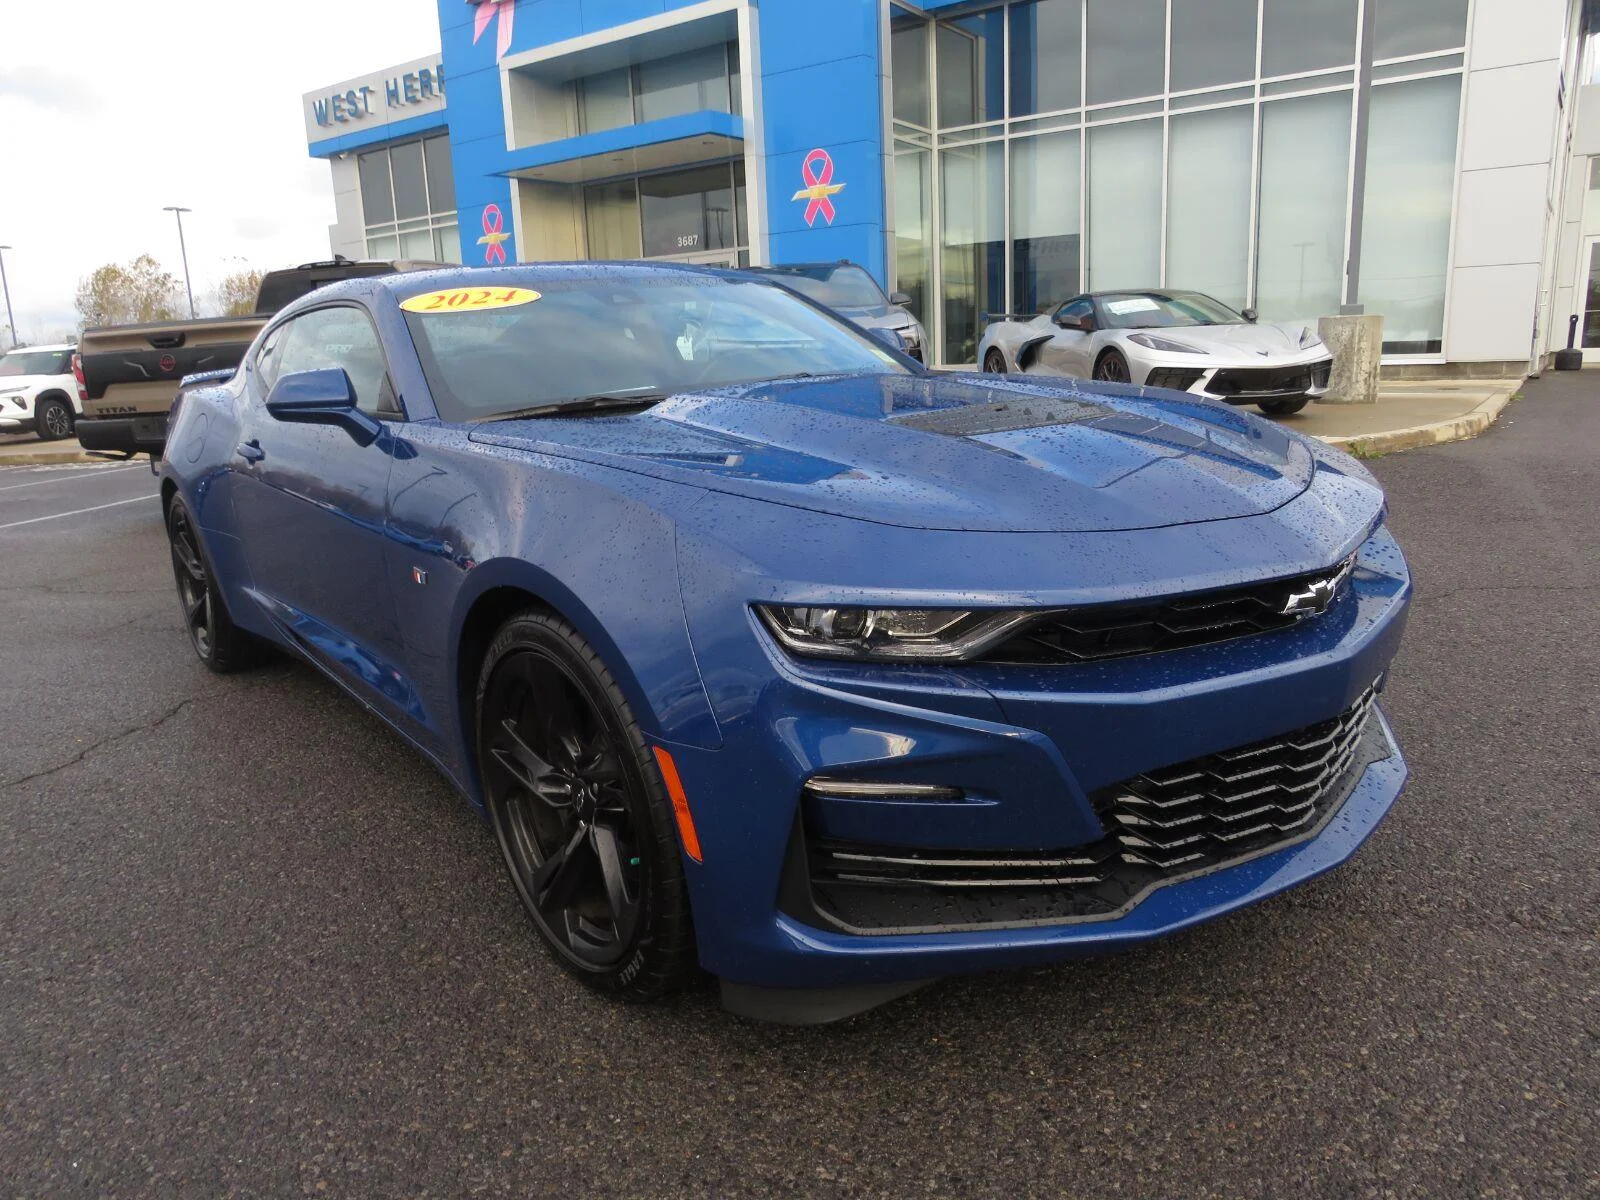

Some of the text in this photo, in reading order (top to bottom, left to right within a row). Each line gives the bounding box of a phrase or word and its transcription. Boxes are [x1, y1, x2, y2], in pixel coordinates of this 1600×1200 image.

[312, 86, 371, 127] WEST
[677, 234, 699, 247] 3687
[425, 289, 517, 310] 2024
[96, 405, 138, 415] TITAN
